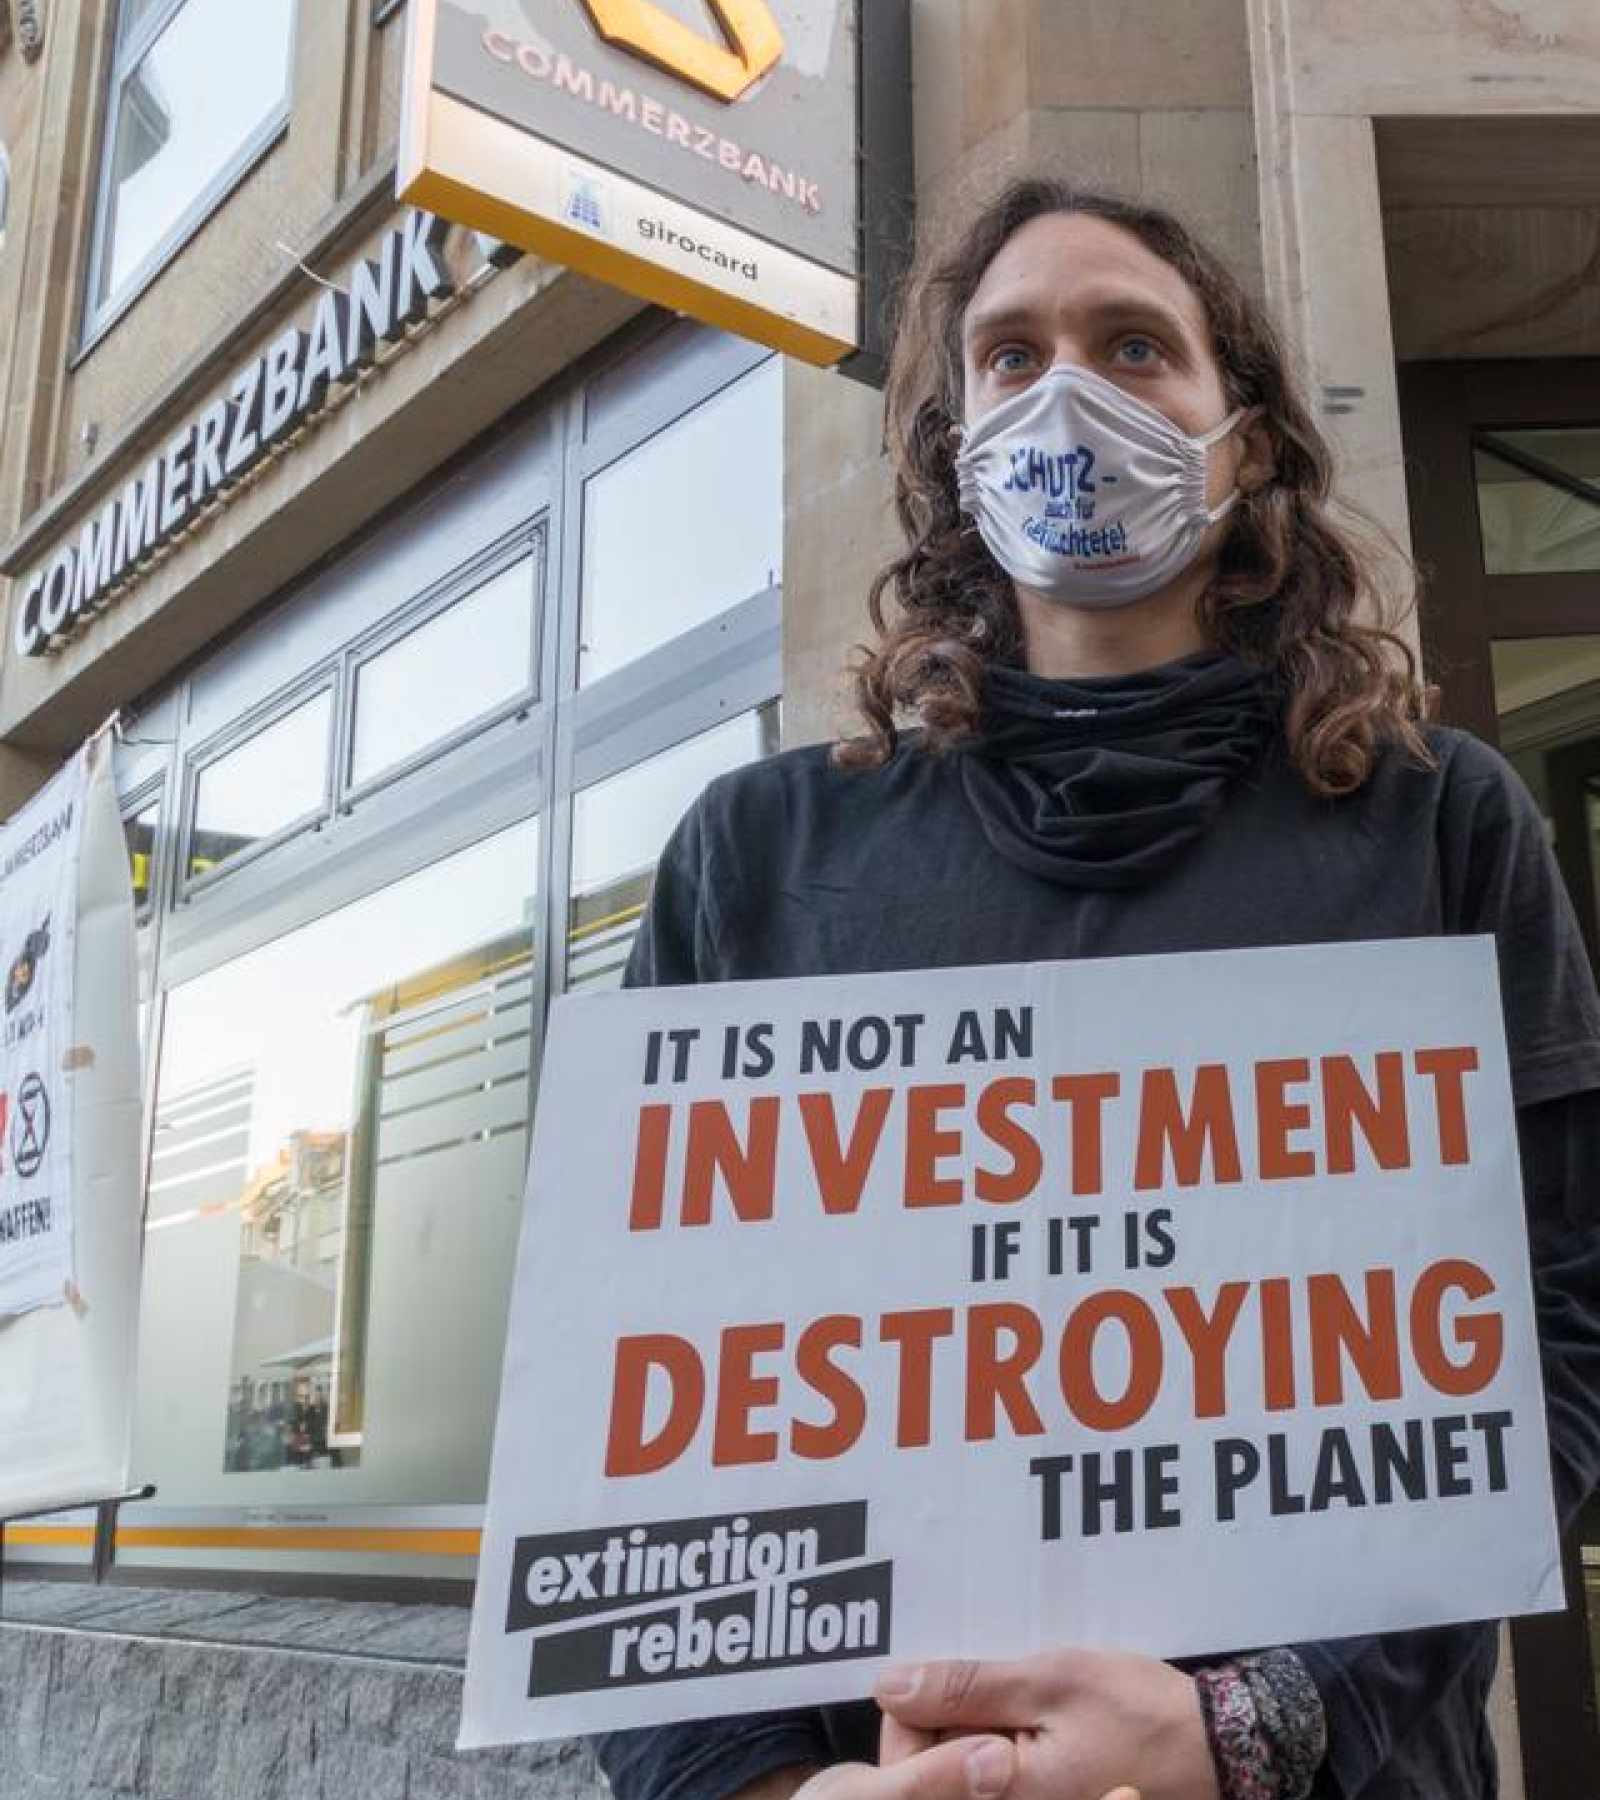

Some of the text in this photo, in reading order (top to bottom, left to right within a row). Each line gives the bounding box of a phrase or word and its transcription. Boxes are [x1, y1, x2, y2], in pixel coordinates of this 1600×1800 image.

[481, 30, 823, 216] COMMERZBANK
[636, 216, 759, 281] girocard
[16, 209, 444, 656] COMMERZBANK
[642, 1006, 1034, 1086] IT IS NOT AN
[629, 1046, 1478, 1232] INVESTMENT
[971, 1207, 1177, 1284] IF IT IS
[604, 1259, 1503, 1478] DESTROYING
[1029, 1410, 1514, 1541] THE PLANET
[526, 1517, 818, 1606] extinction
[609, 1580, 881, 1678] rebellion
